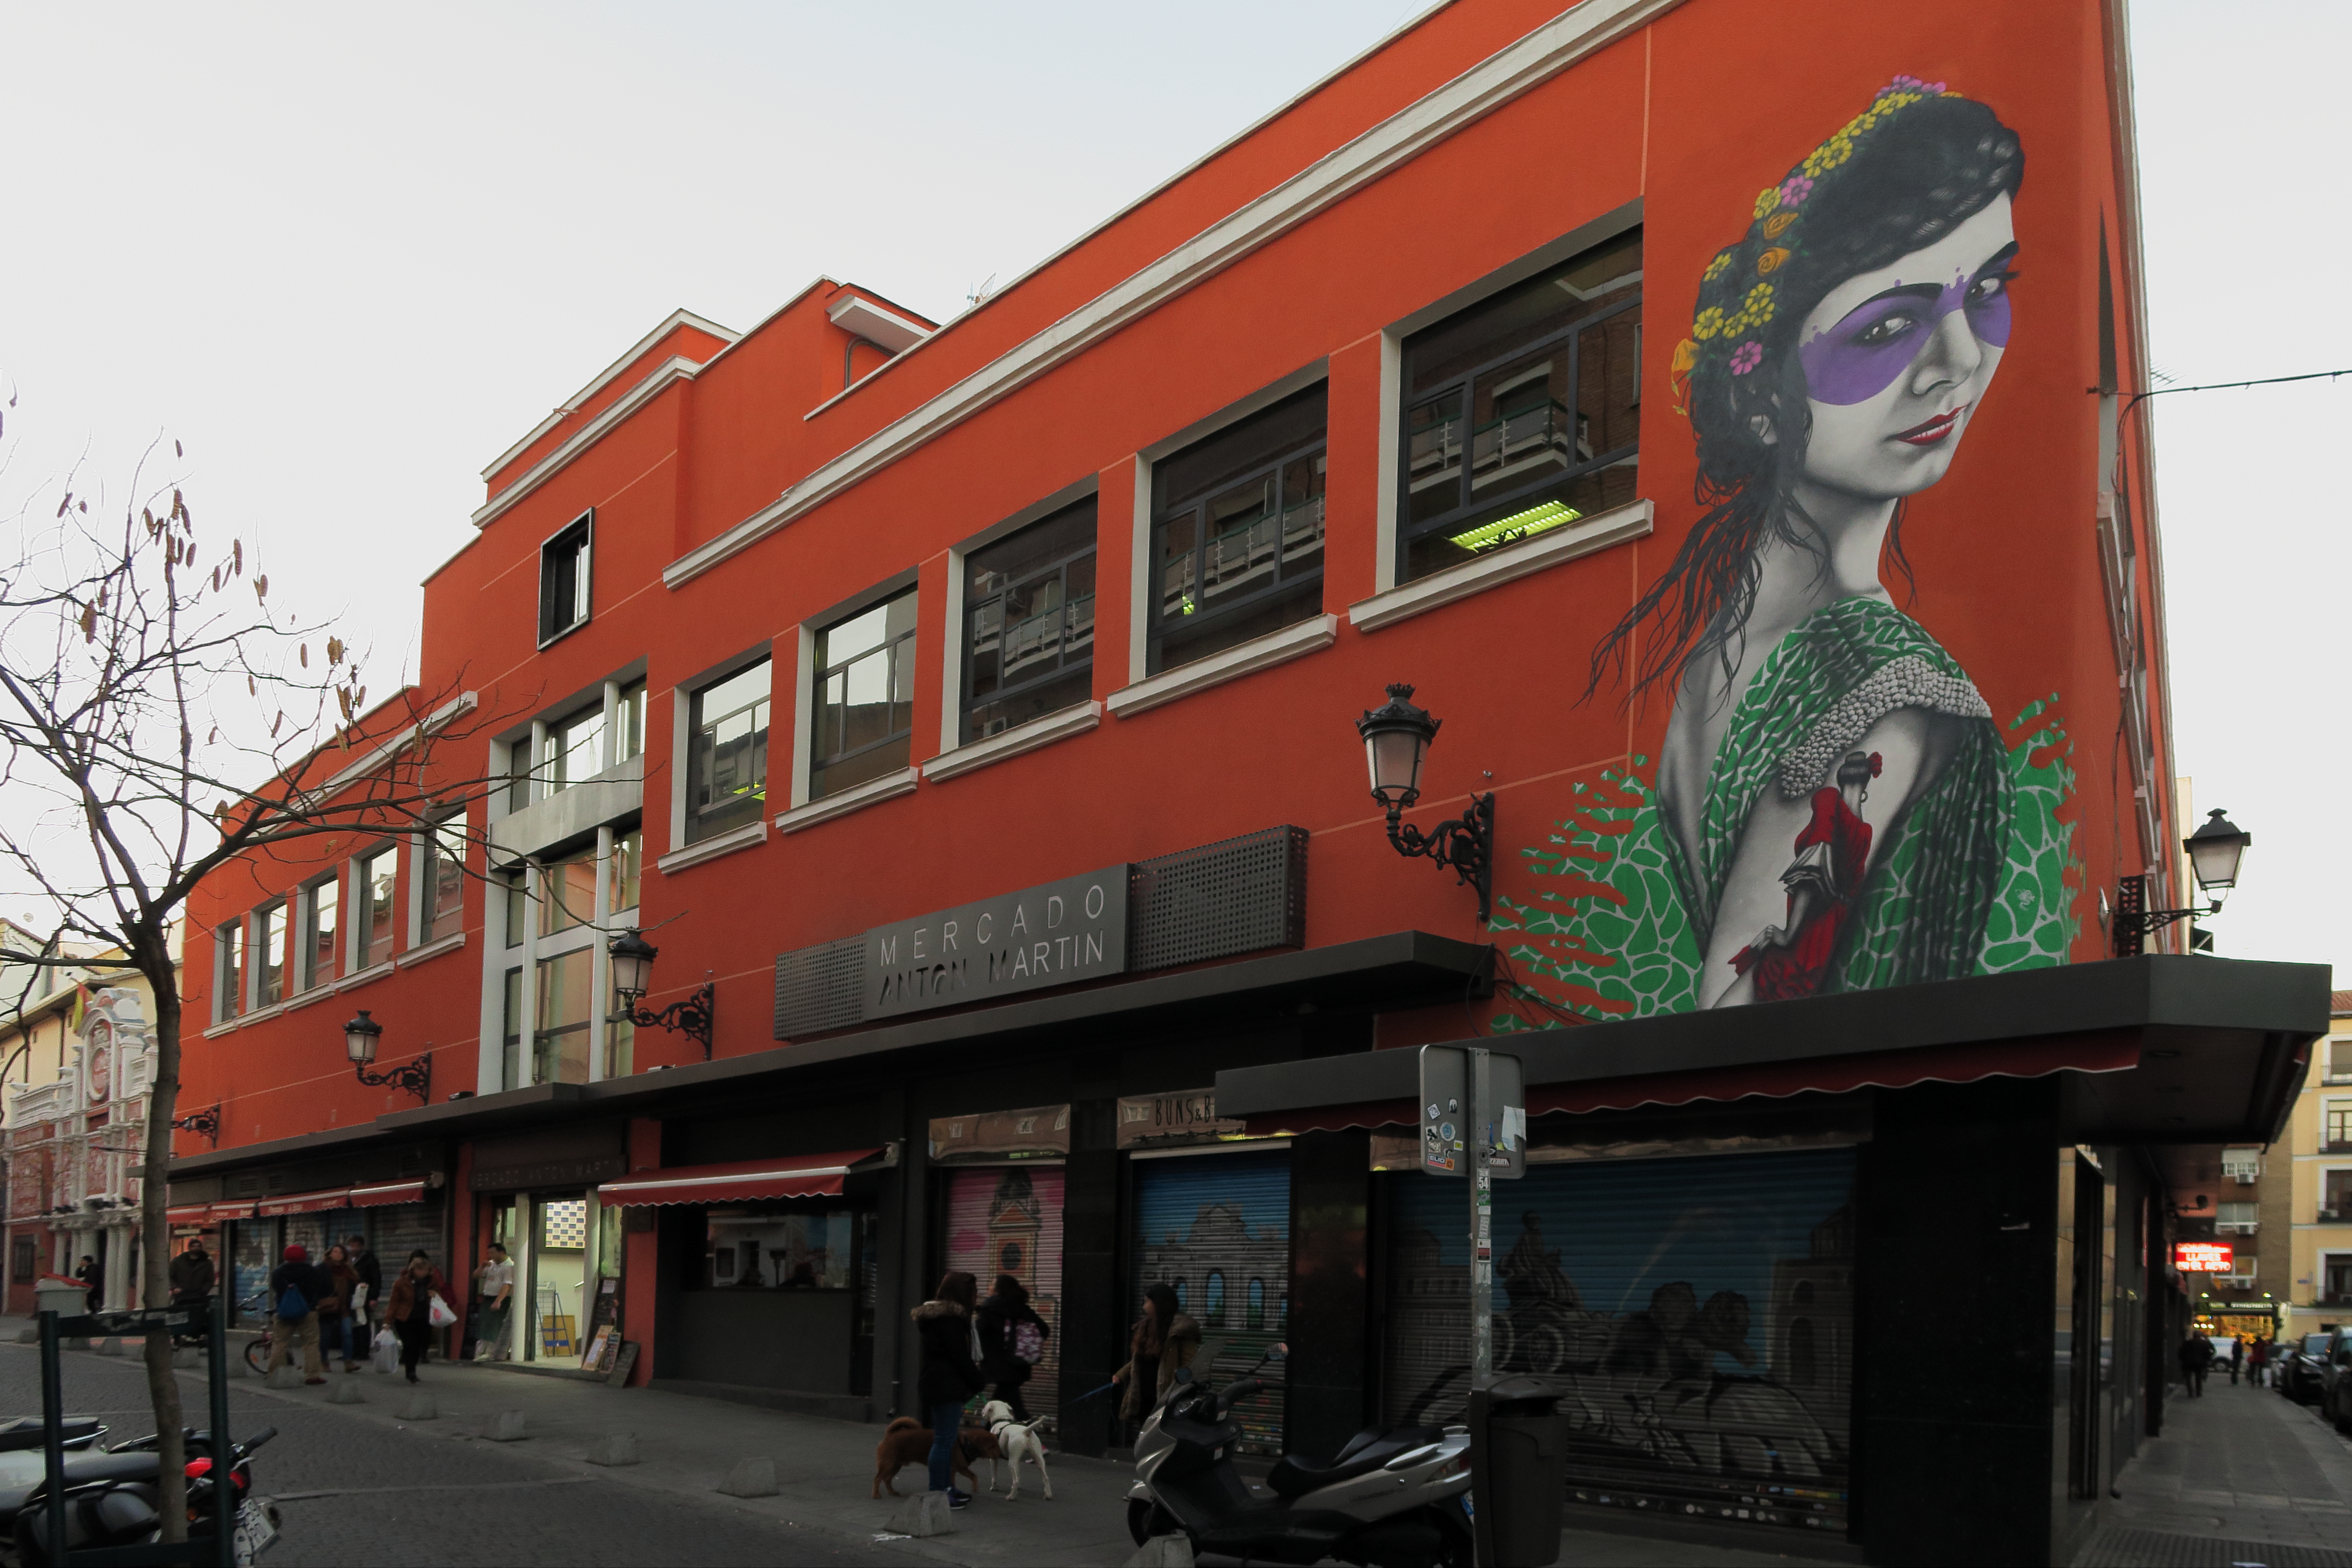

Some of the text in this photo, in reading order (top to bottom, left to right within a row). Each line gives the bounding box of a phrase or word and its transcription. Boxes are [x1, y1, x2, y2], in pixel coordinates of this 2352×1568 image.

[880, 885, 1104, 967] MERCADO
[879, 929, 1103, 1005] ANTON MARTIN
[1479, 1177, 1488, 1189] 54
[2186, 1253, 2221, 1262] LLAVES
